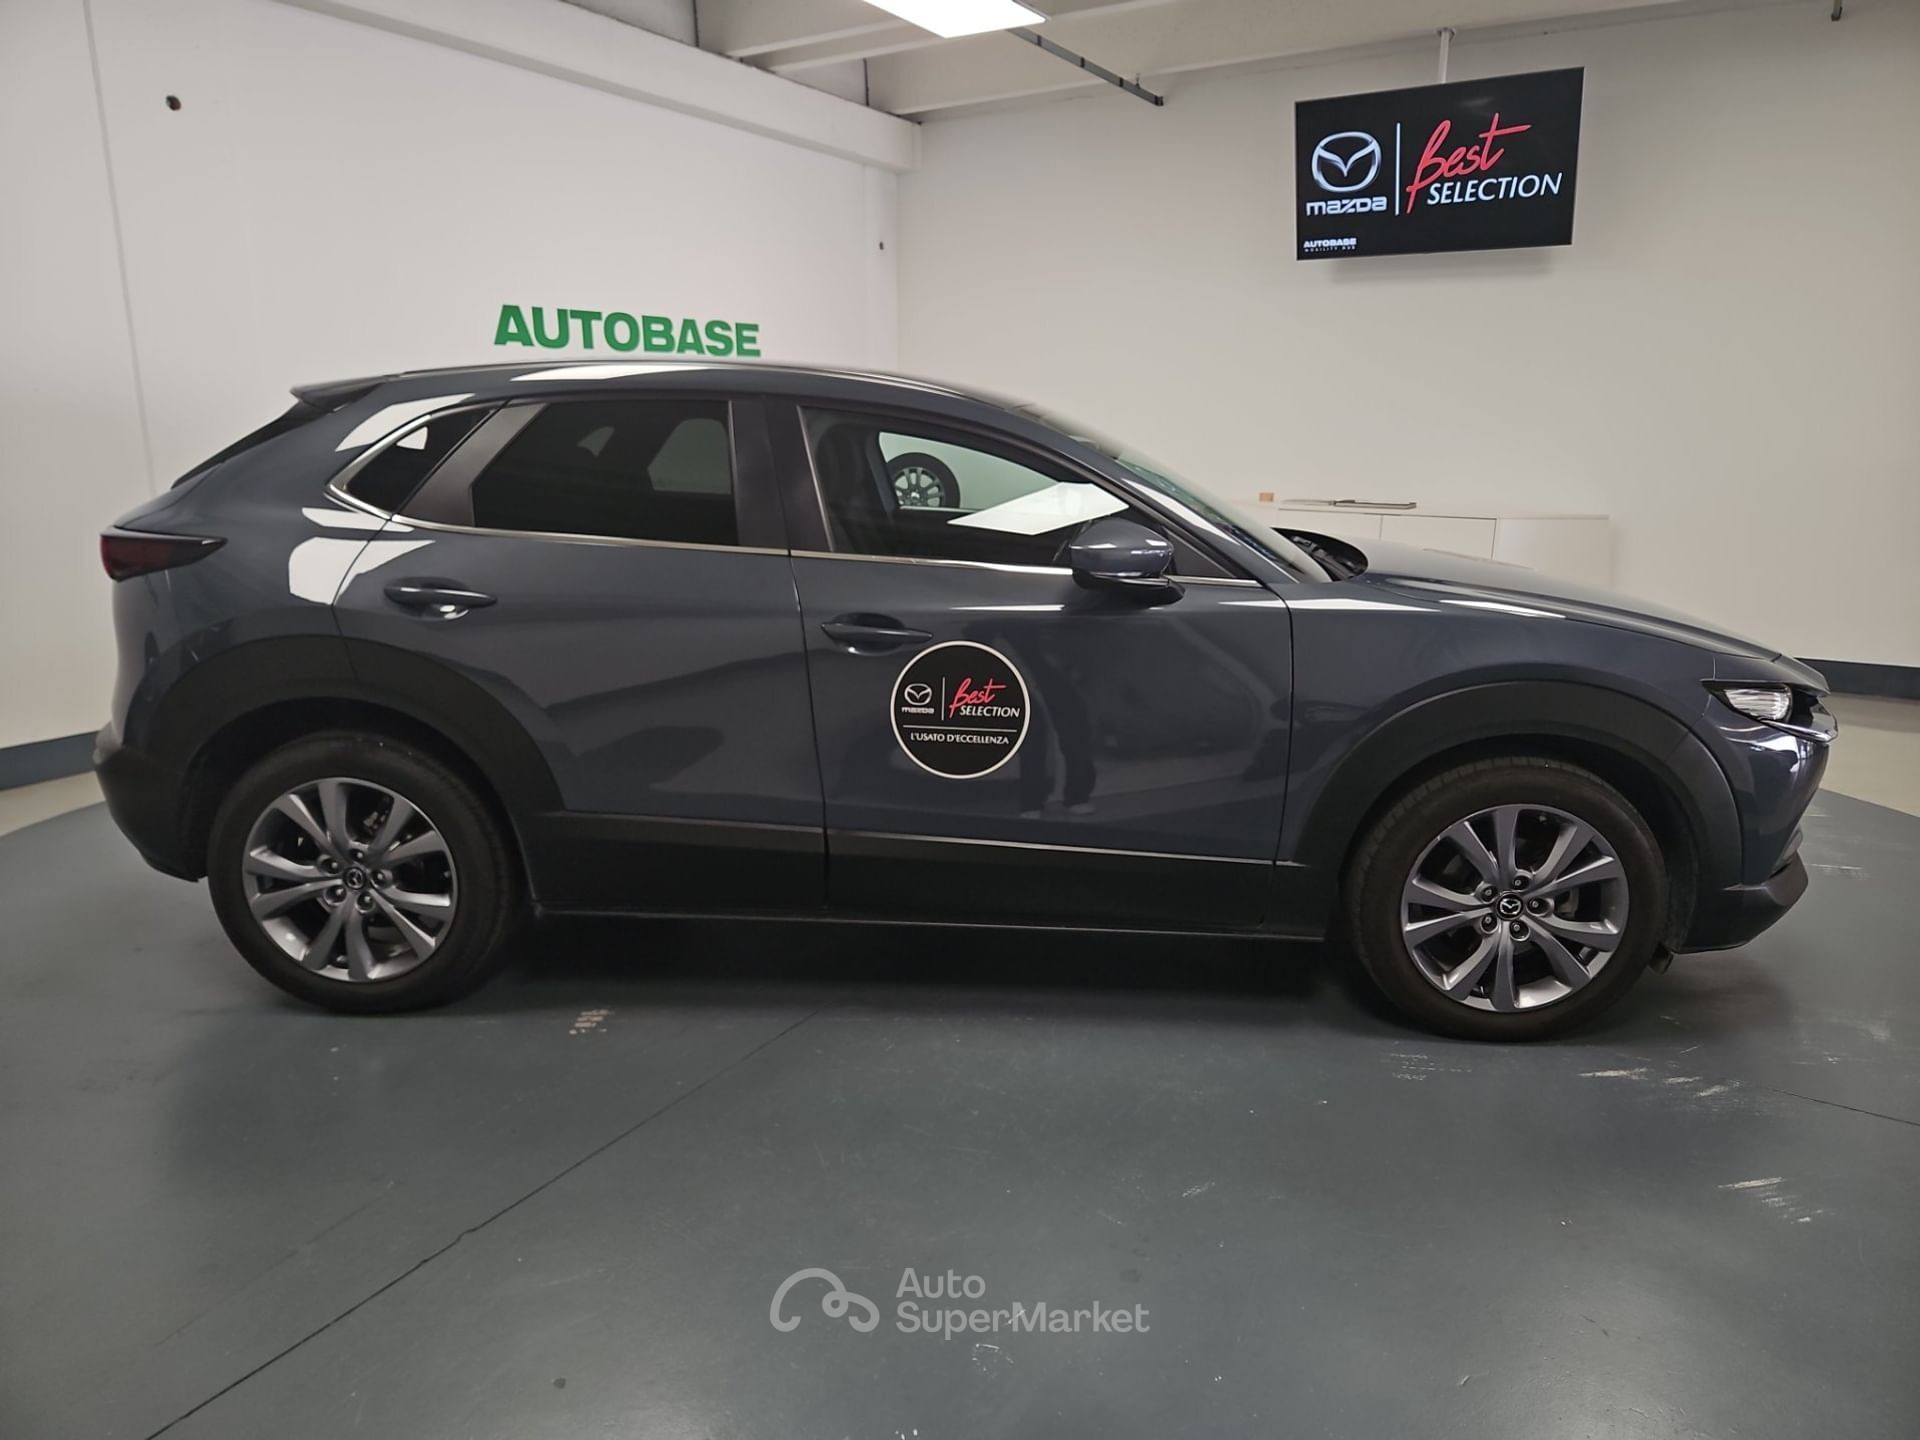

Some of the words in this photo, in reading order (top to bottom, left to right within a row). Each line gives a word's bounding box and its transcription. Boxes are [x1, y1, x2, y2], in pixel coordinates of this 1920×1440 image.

[1426, 172, 1563, 206] SELECTION
[494, 304, 761, 357] AUTOBASE
[959, 705, 1020, 718] SELECTION
[910, 732, 945, 742] L'USATO
[946, 734, 1009, 745] D'ECCELLENZA
